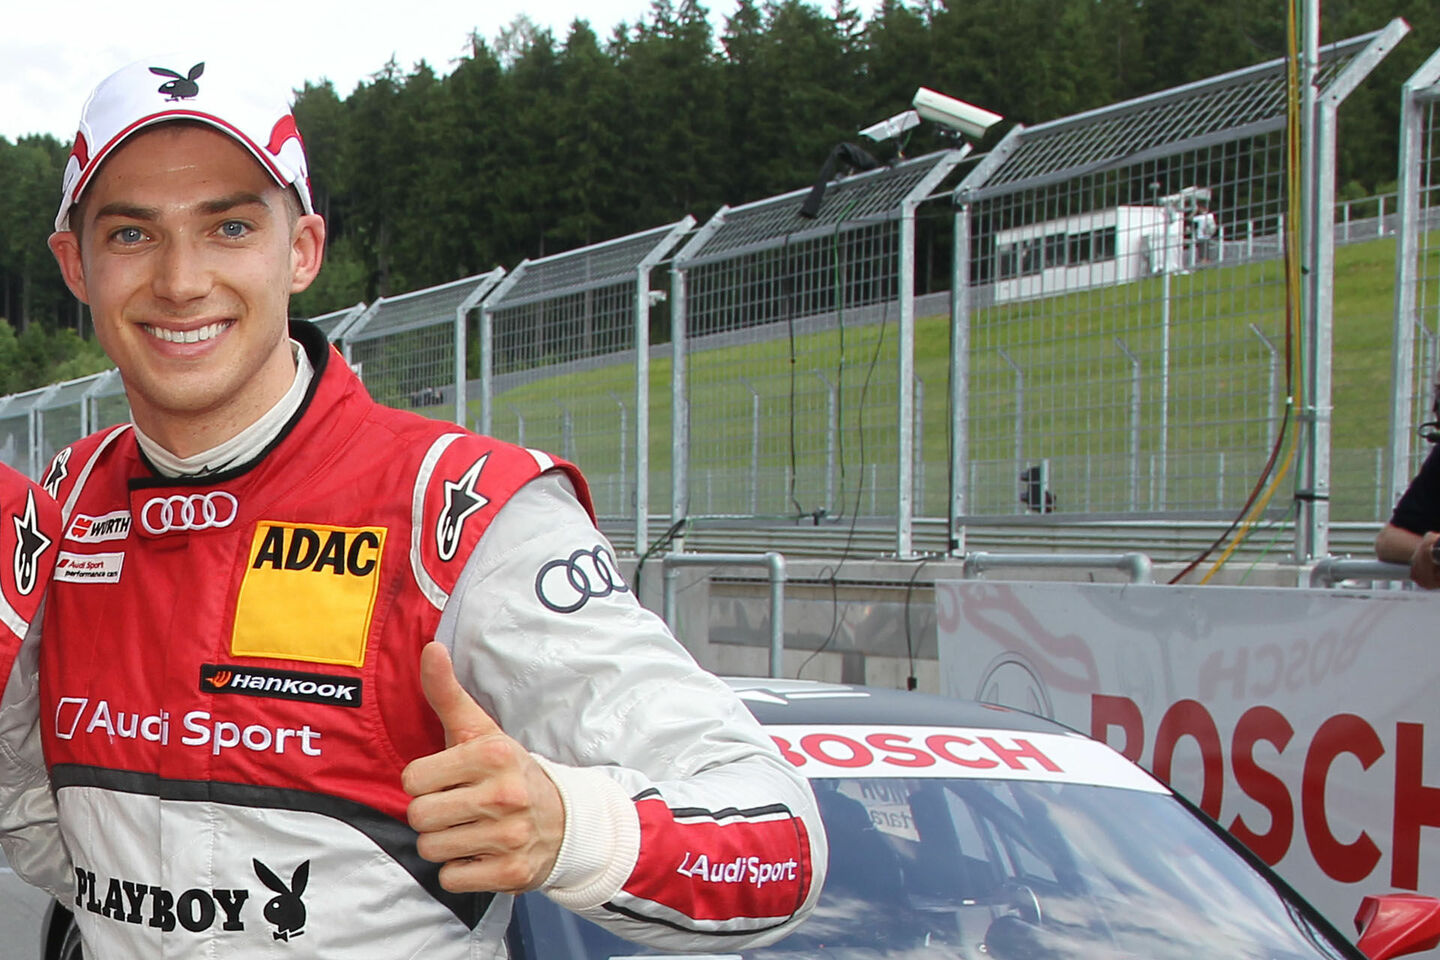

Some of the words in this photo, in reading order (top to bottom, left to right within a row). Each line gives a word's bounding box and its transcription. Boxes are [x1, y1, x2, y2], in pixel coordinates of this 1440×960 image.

[253, 526, 379, 576] ADAC
[86, 700, 169, 745] Audi
[182, 710, 323, 758] Sport
[75, 867, 250, 932] PLAYBOY
